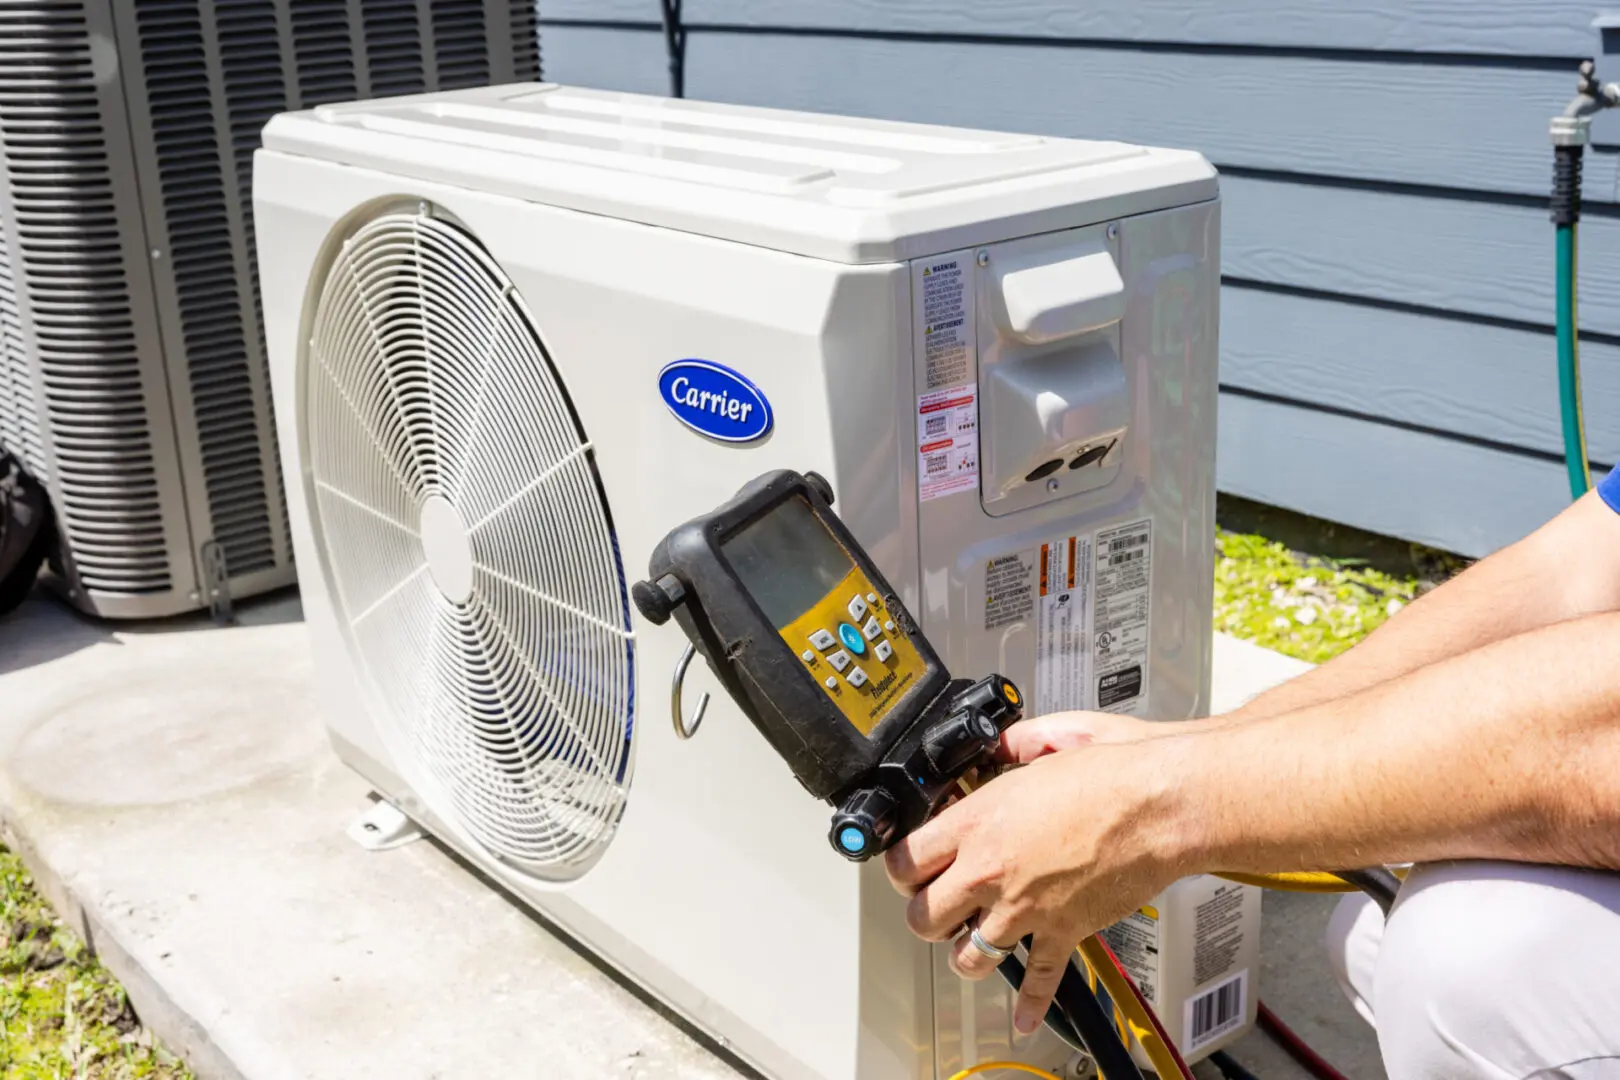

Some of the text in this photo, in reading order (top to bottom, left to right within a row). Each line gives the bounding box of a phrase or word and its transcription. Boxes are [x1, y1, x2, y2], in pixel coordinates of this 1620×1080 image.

[933, 261, 957, 272] WARNING
[671, 376, 752, 422] Carrier
[843, 835, 862, 845] LOW
